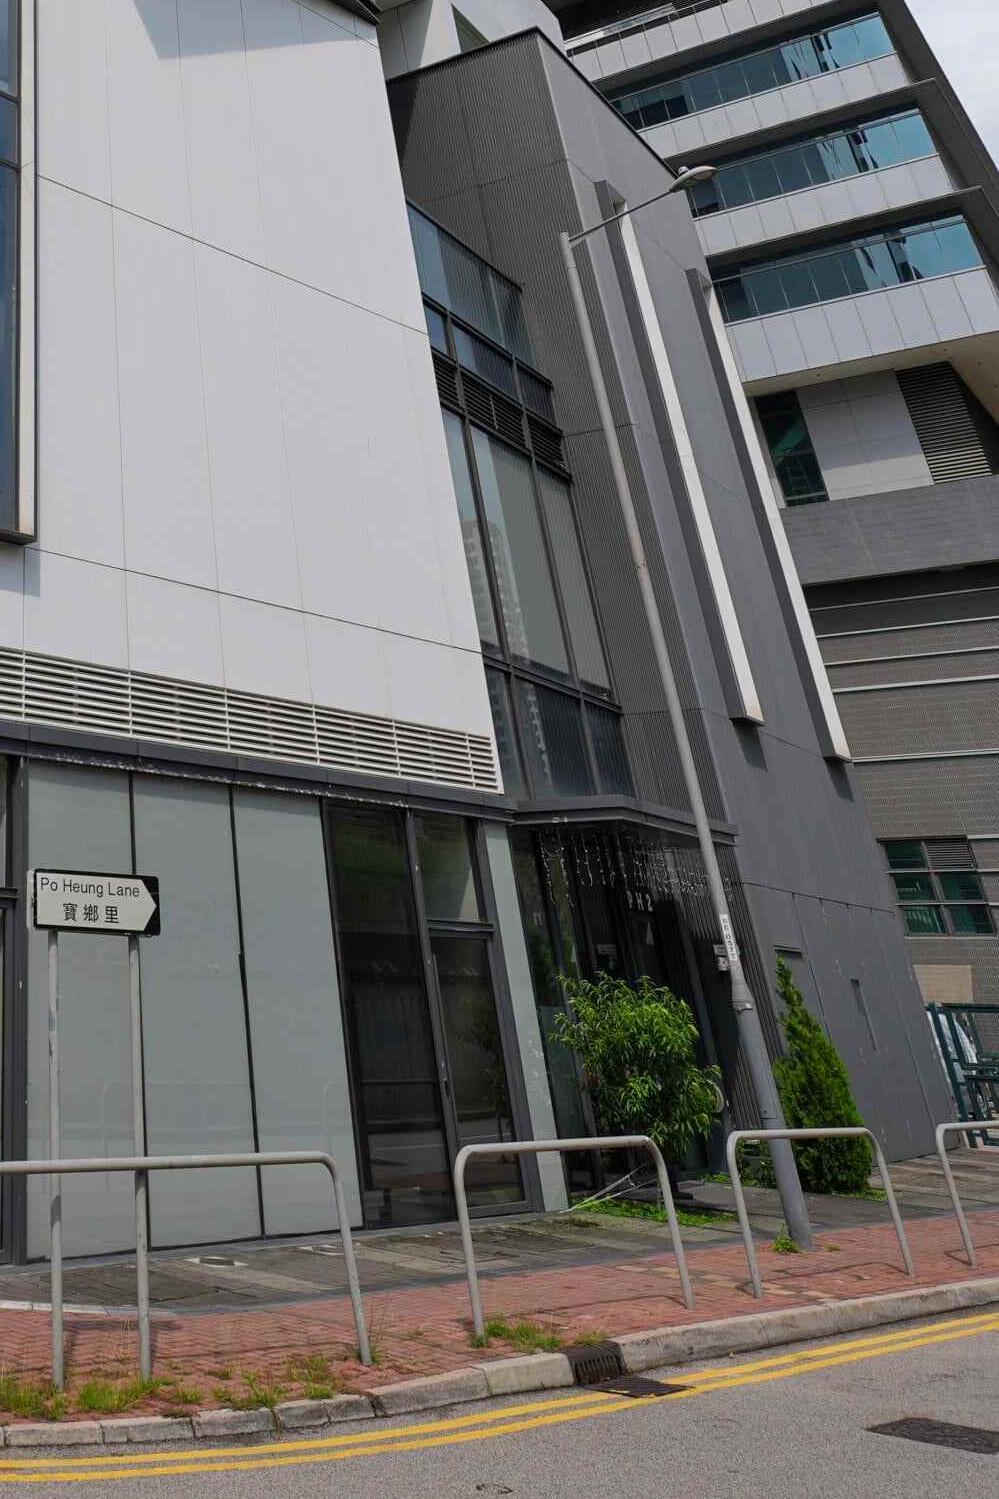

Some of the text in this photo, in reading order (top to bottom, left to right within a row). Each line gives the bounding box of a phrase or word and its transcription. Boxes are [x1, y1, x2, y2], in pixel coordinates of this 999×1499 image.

[40, 877, 140, 897] Po Heung Lane
[63, 903, 120, 924] 寶鄉里
